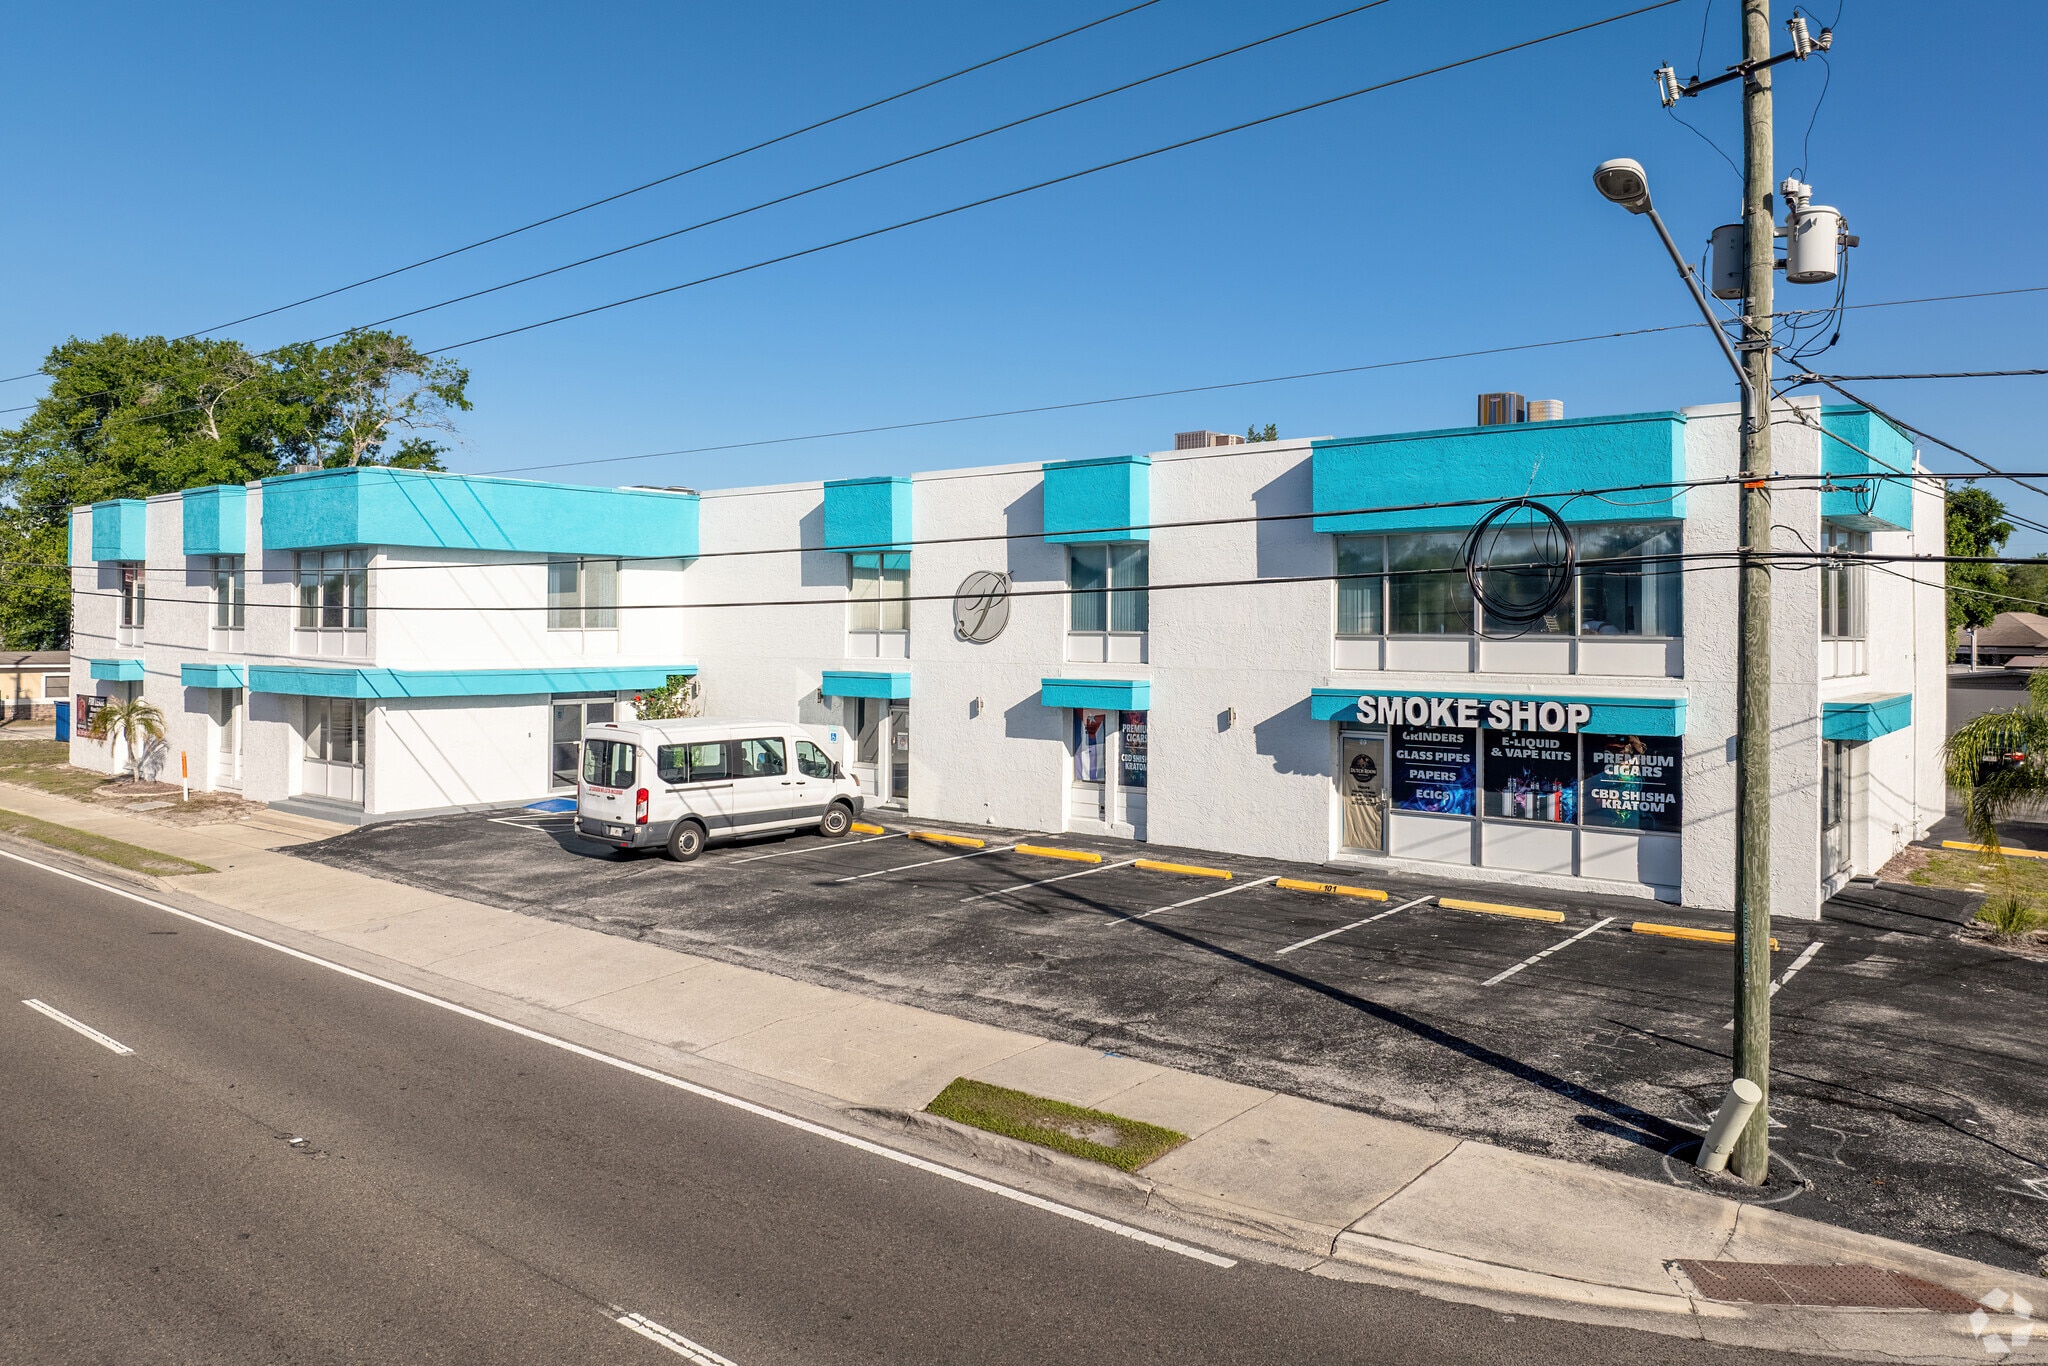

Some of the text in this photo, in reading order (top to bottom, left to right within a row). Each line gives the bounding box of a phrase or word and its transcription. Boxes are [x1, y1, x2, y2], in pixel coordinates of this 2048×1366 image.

[1356, 695, 1592, 734] SMOKE SHOP
[1122, 723, 1147, 734] PREMIU
[1402, 731, 1464, 743] GRINDERS
[1501, 736, 1560, 749] E-LIQUID
[1396, 749, 1471, 763] GLASS PIPES
[1490, 747, 1572, 761] & VAPE KITS
[1593, 752, 1674, 767] PREMIUM
[1409, 769, 1457, 781] PAPERS
[1604, 764, 1663, 778] CIGARS
[1416, 789, 1450, 800] ECIGS
[1591, 788, 1676, 804] CBD SHISHA
[1601, 799, 1665, 813] KRATOM
